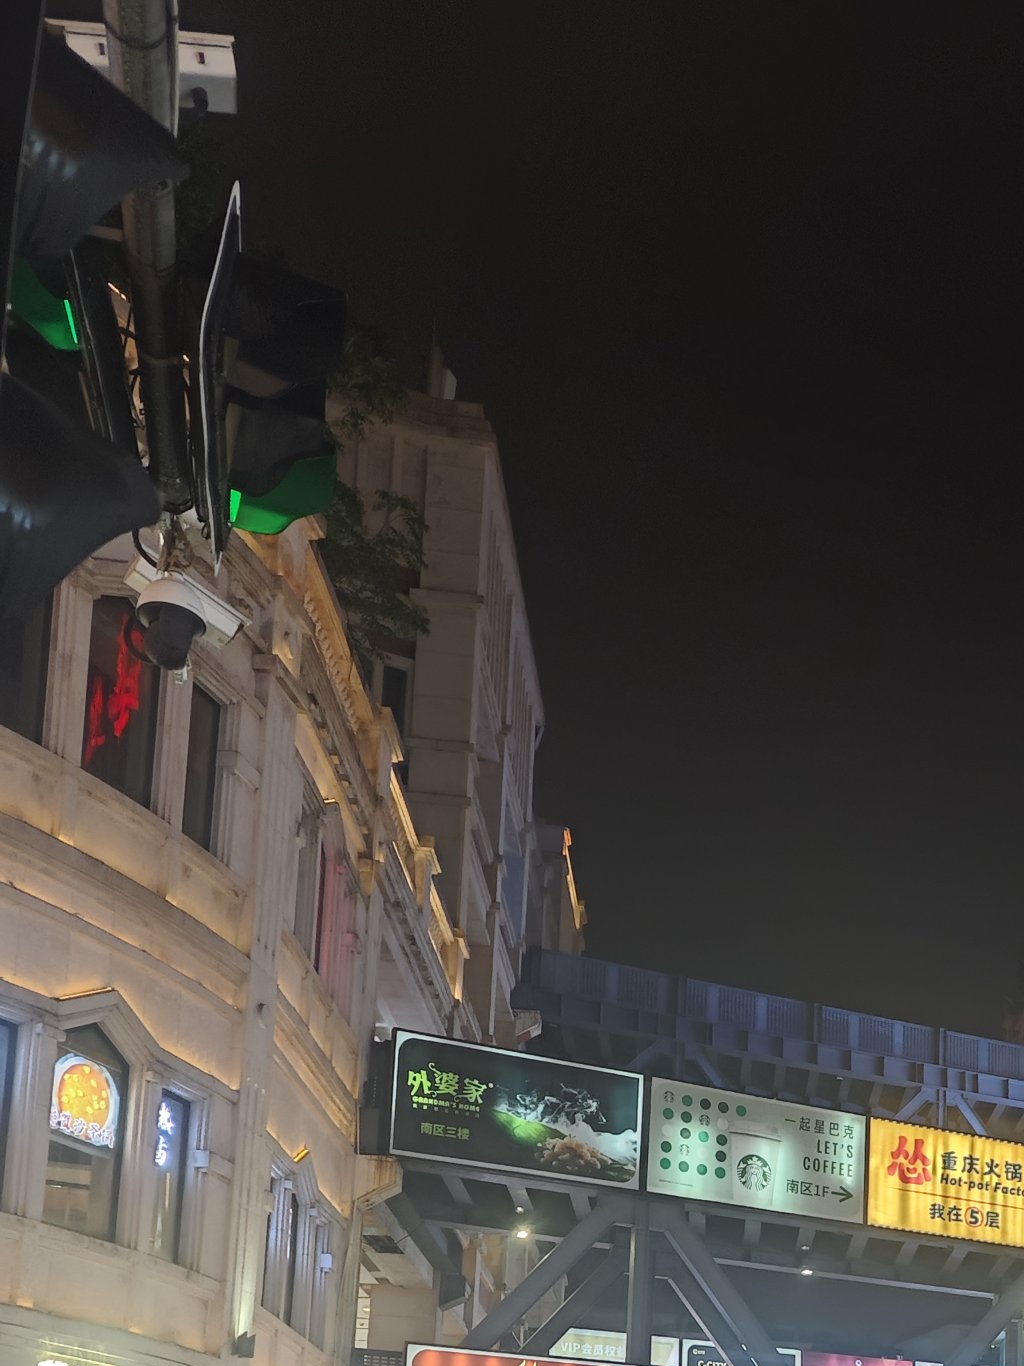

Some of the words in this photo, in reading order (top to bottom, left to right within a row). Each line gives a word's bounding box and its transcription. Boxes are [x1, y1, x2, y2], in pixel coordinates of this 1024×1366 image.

[407, 1062, 487, 1104] 外婆家
[412, 1095, 457, 1108] GRANDMA'S
[458, 1103, 480, 1112] HOME
[420, 1122, 470, 1141] 南区三楼
[784, 1116, 855, 1140] 一起星巴克
[816, 1139, 854, 1159] LET'S
[803, 1156, 854, 1178] COFFEE
[887, 1135, 933, 1186] 怂
[786, 1178, 831, 1198] 南区1F
[939, 1173, 991, 1192] Hot-pot
[929, 1203, 1001, 1230] 我在5层
